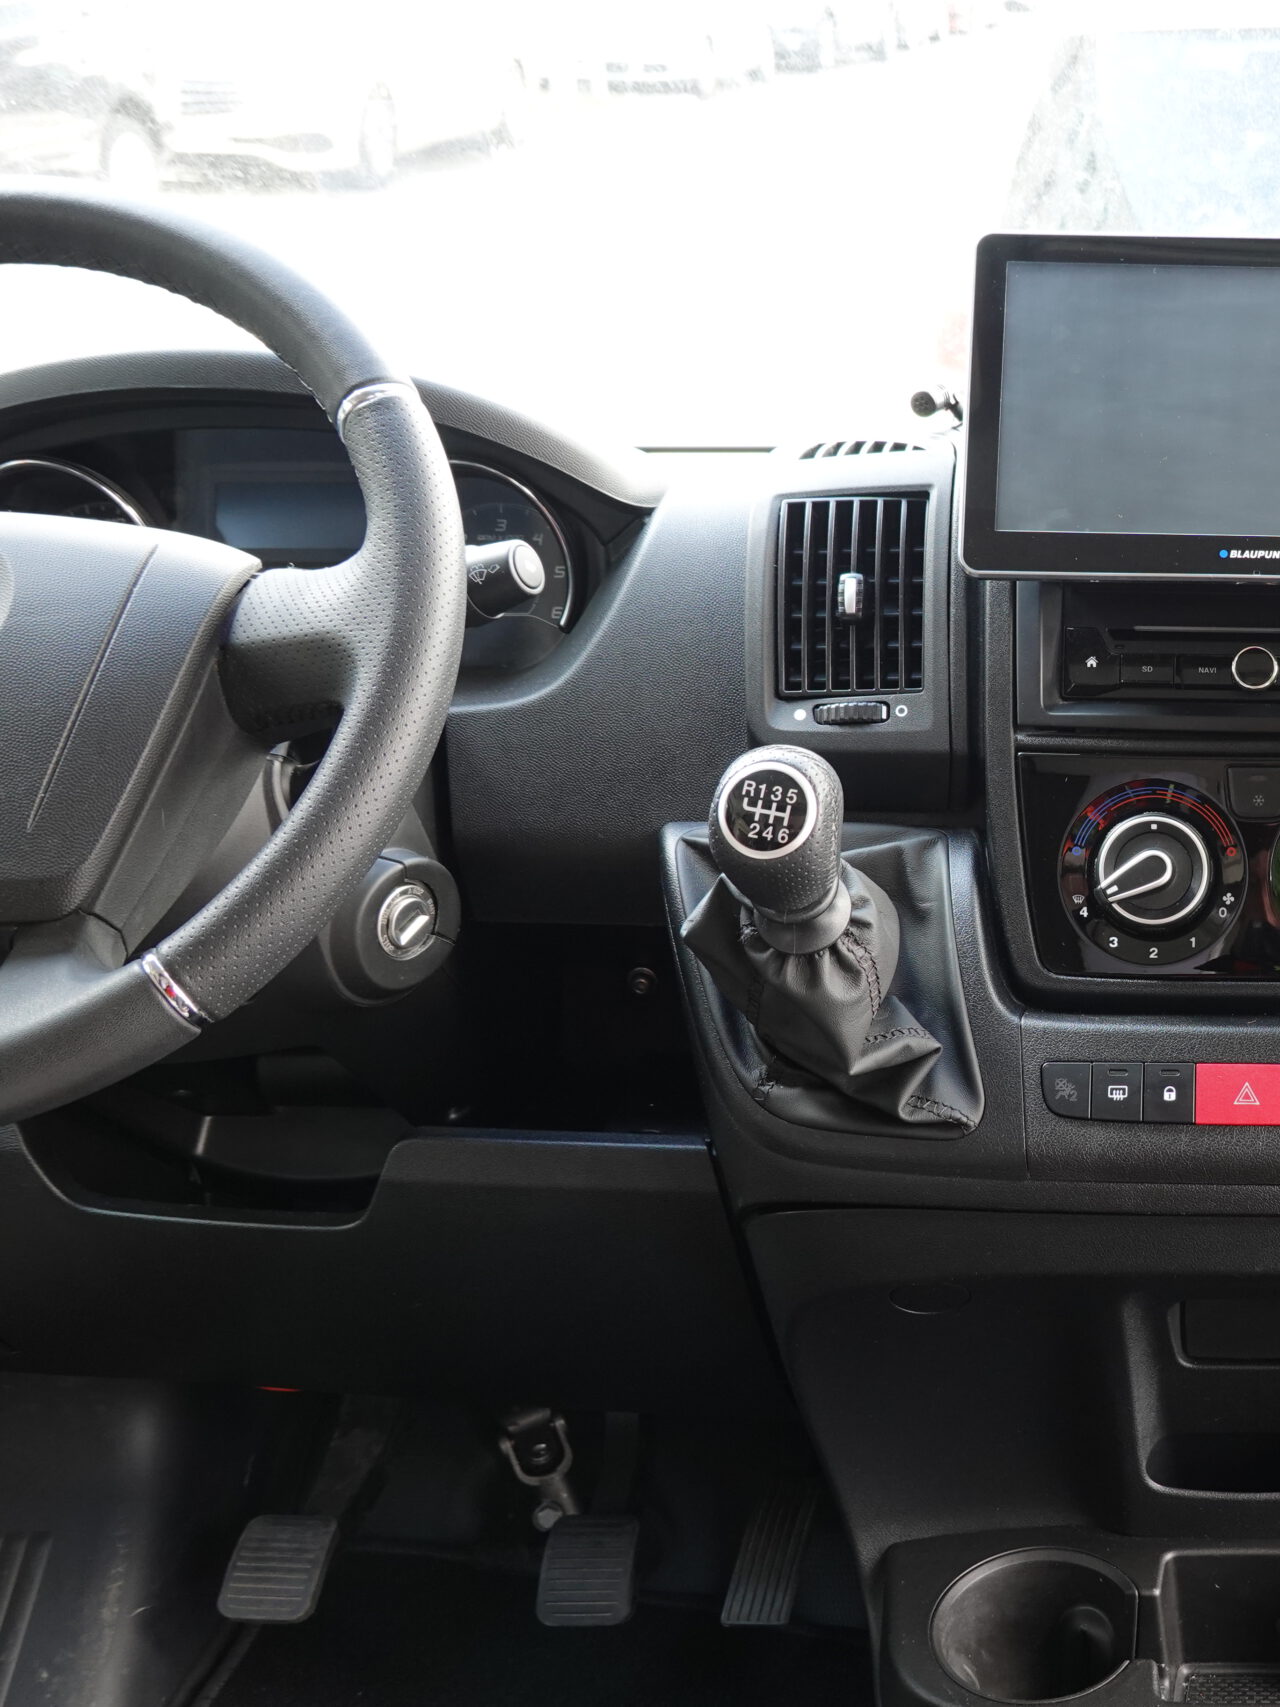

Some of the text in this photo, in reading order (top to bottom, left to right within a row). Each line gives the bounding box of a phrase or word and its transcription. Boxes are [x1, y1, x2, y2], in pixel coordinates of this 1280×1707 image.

[494, 519, 508, 531] 3
[533, 533, 543, 546] 4
[553, 565, 566, 578] 5
[1141, 665, 1153, 673] SD
[1079, 906, 1089, 918] 4
[1108, 936, 1119, 948] 3
[1190, 936, 1197, 948] 1
[1149, 947, 1159, 959] 2
